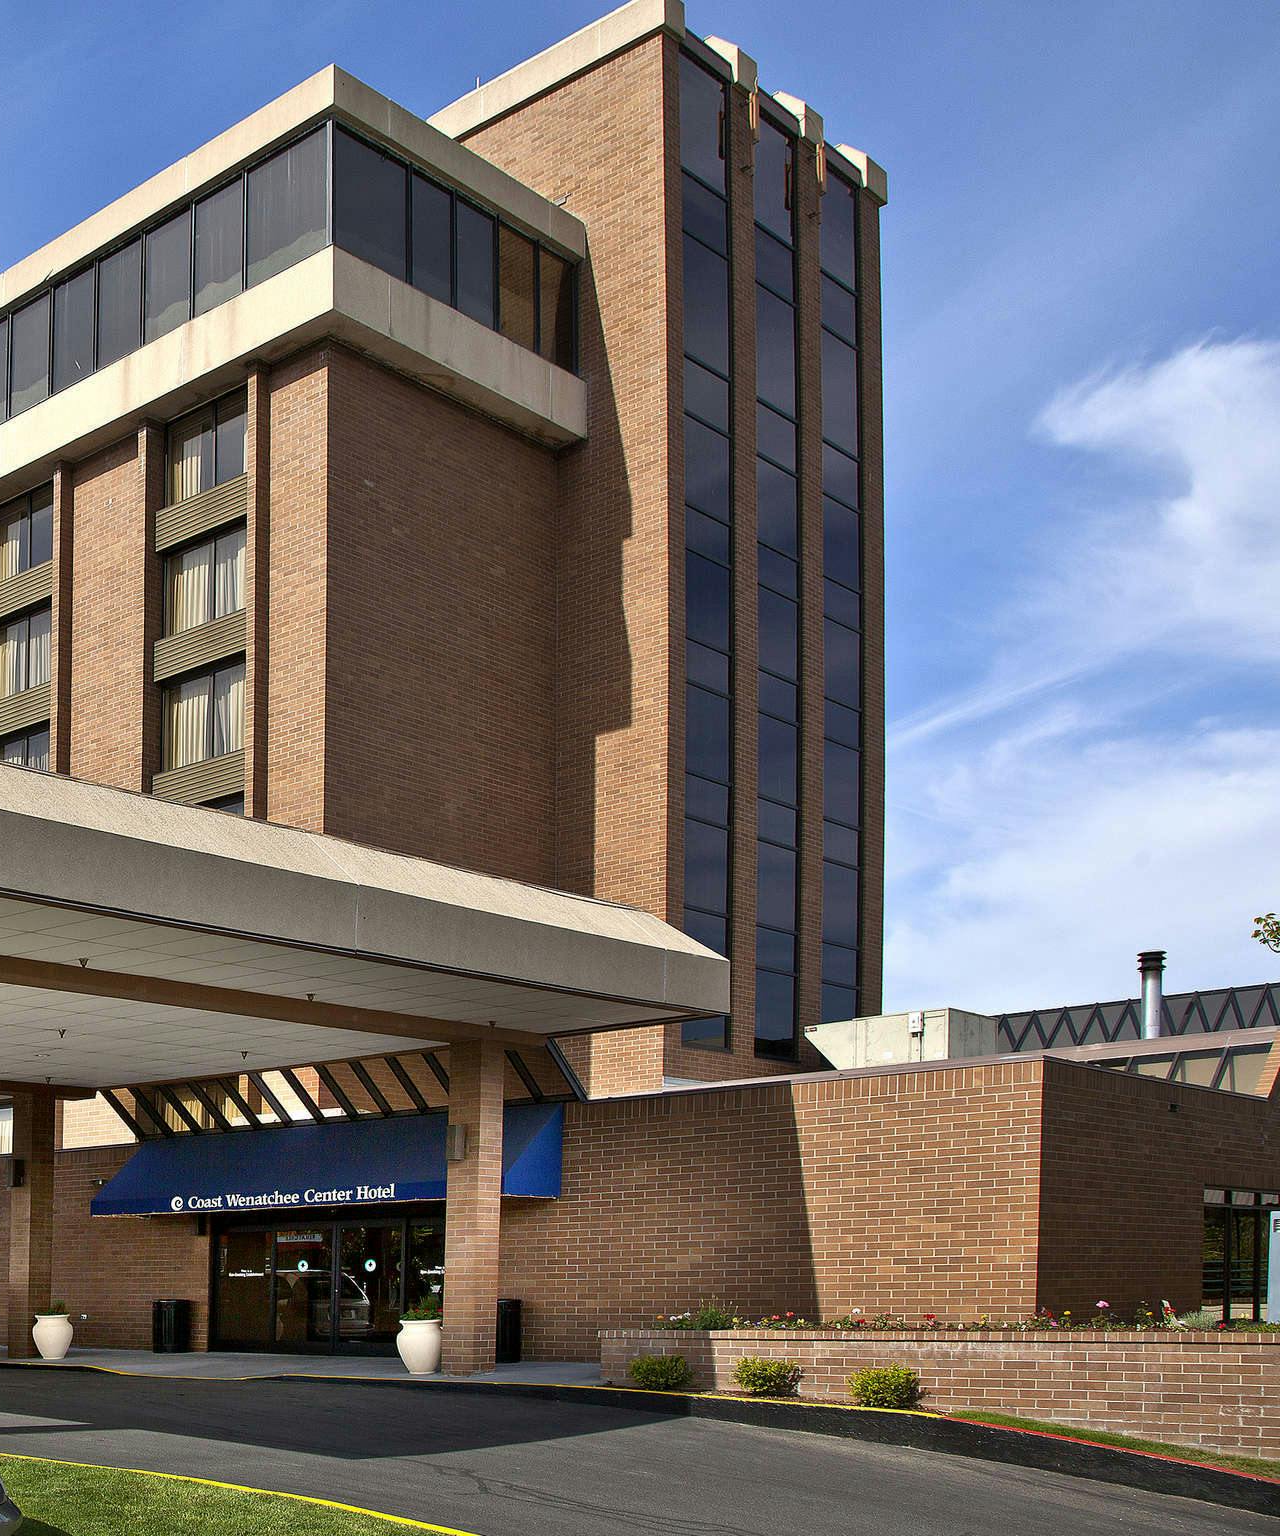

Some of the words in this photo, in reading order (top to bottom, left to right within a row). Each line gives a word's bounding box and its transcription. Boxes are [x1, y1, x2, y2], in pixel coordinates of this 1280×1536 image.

[187, 1195, 223, 1209] Coast
[225, 1191, 300, 1207] Wenatchee
[304, 1188, 353, 1203] Center
[356, 1183, 395, 1200] Hotel
